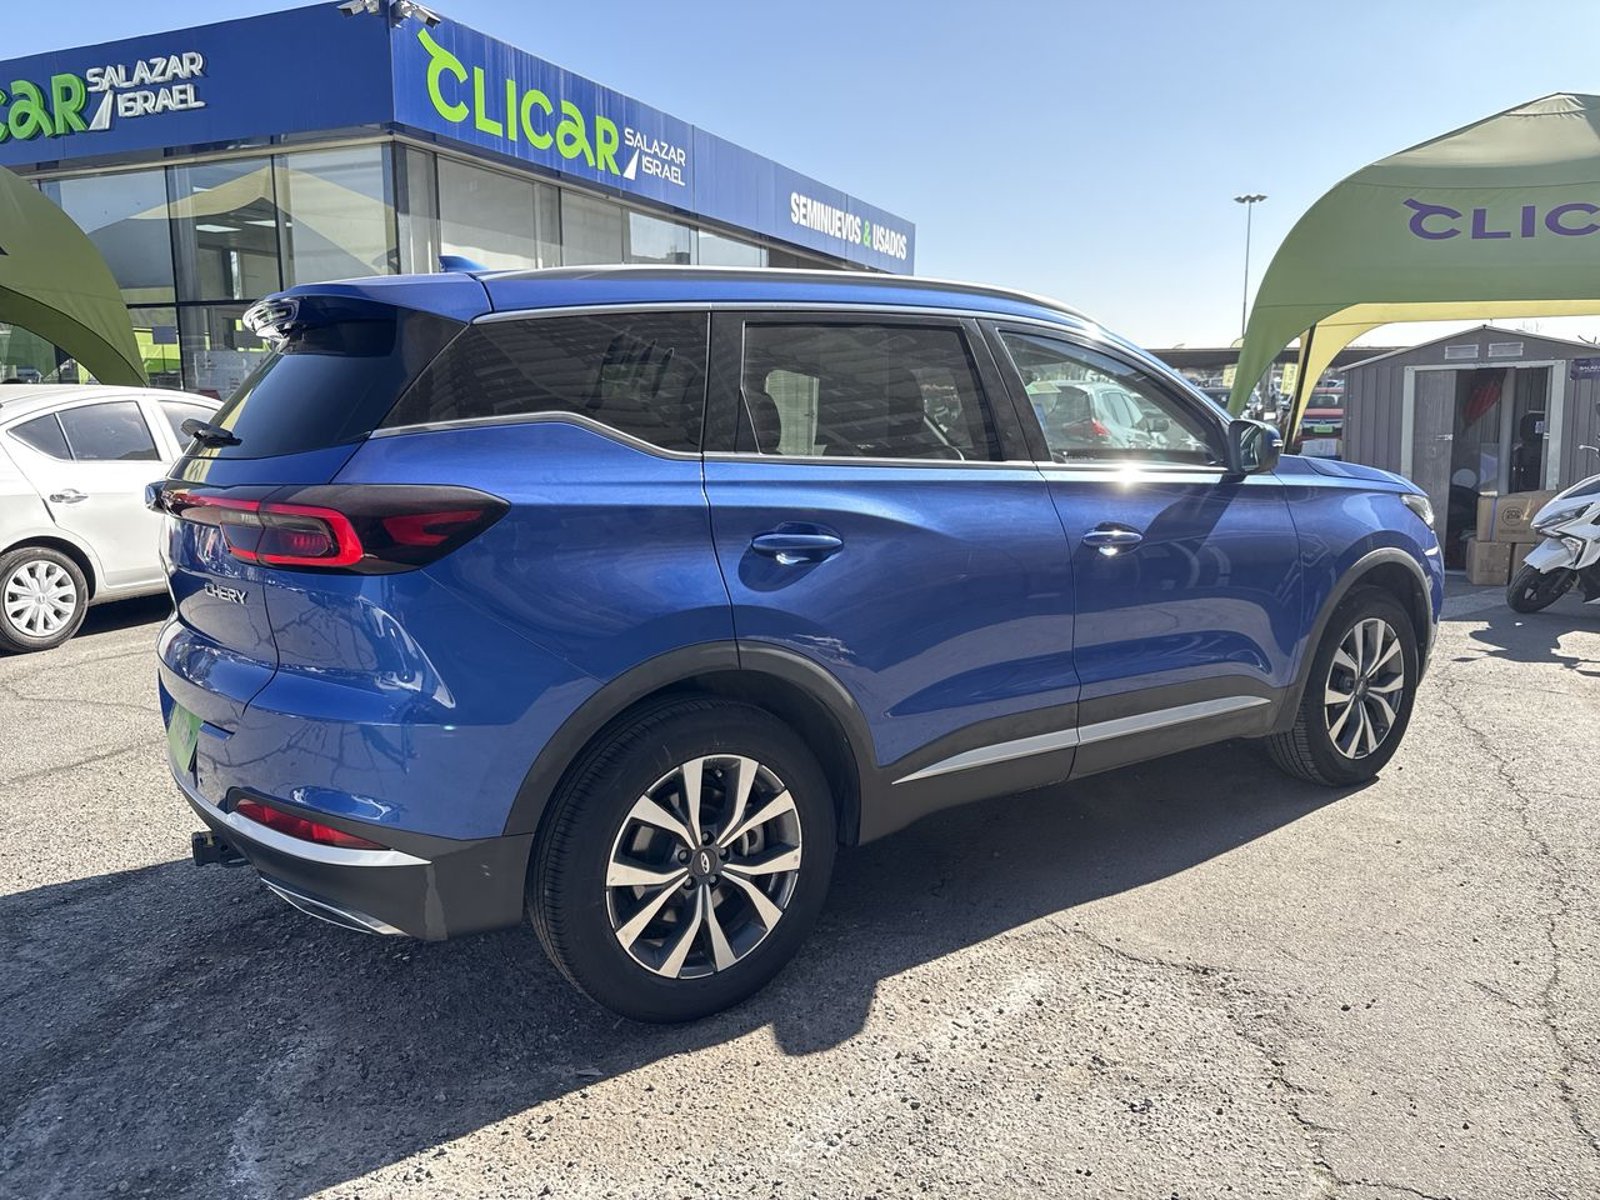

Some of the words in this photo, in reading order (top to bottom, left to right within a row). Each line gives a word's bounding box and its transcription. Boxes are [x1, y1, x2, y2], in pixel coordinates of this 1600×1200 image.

[86, 52, 204, 92] SALAZAR
[117, 83, 206, 117] ISRAEL
[624, 127, 686, 166] SALAZAR
[641, 154, 686, 186] ISRAEL
[790, 192, 861, 245] SEMINUEVOS
[863, 220, 871, 248] &
[872, 223, 907, 260] USADOS
[1403, 199, 1600, 240] CLIC
[204, 582, 248, 605] CHERY
